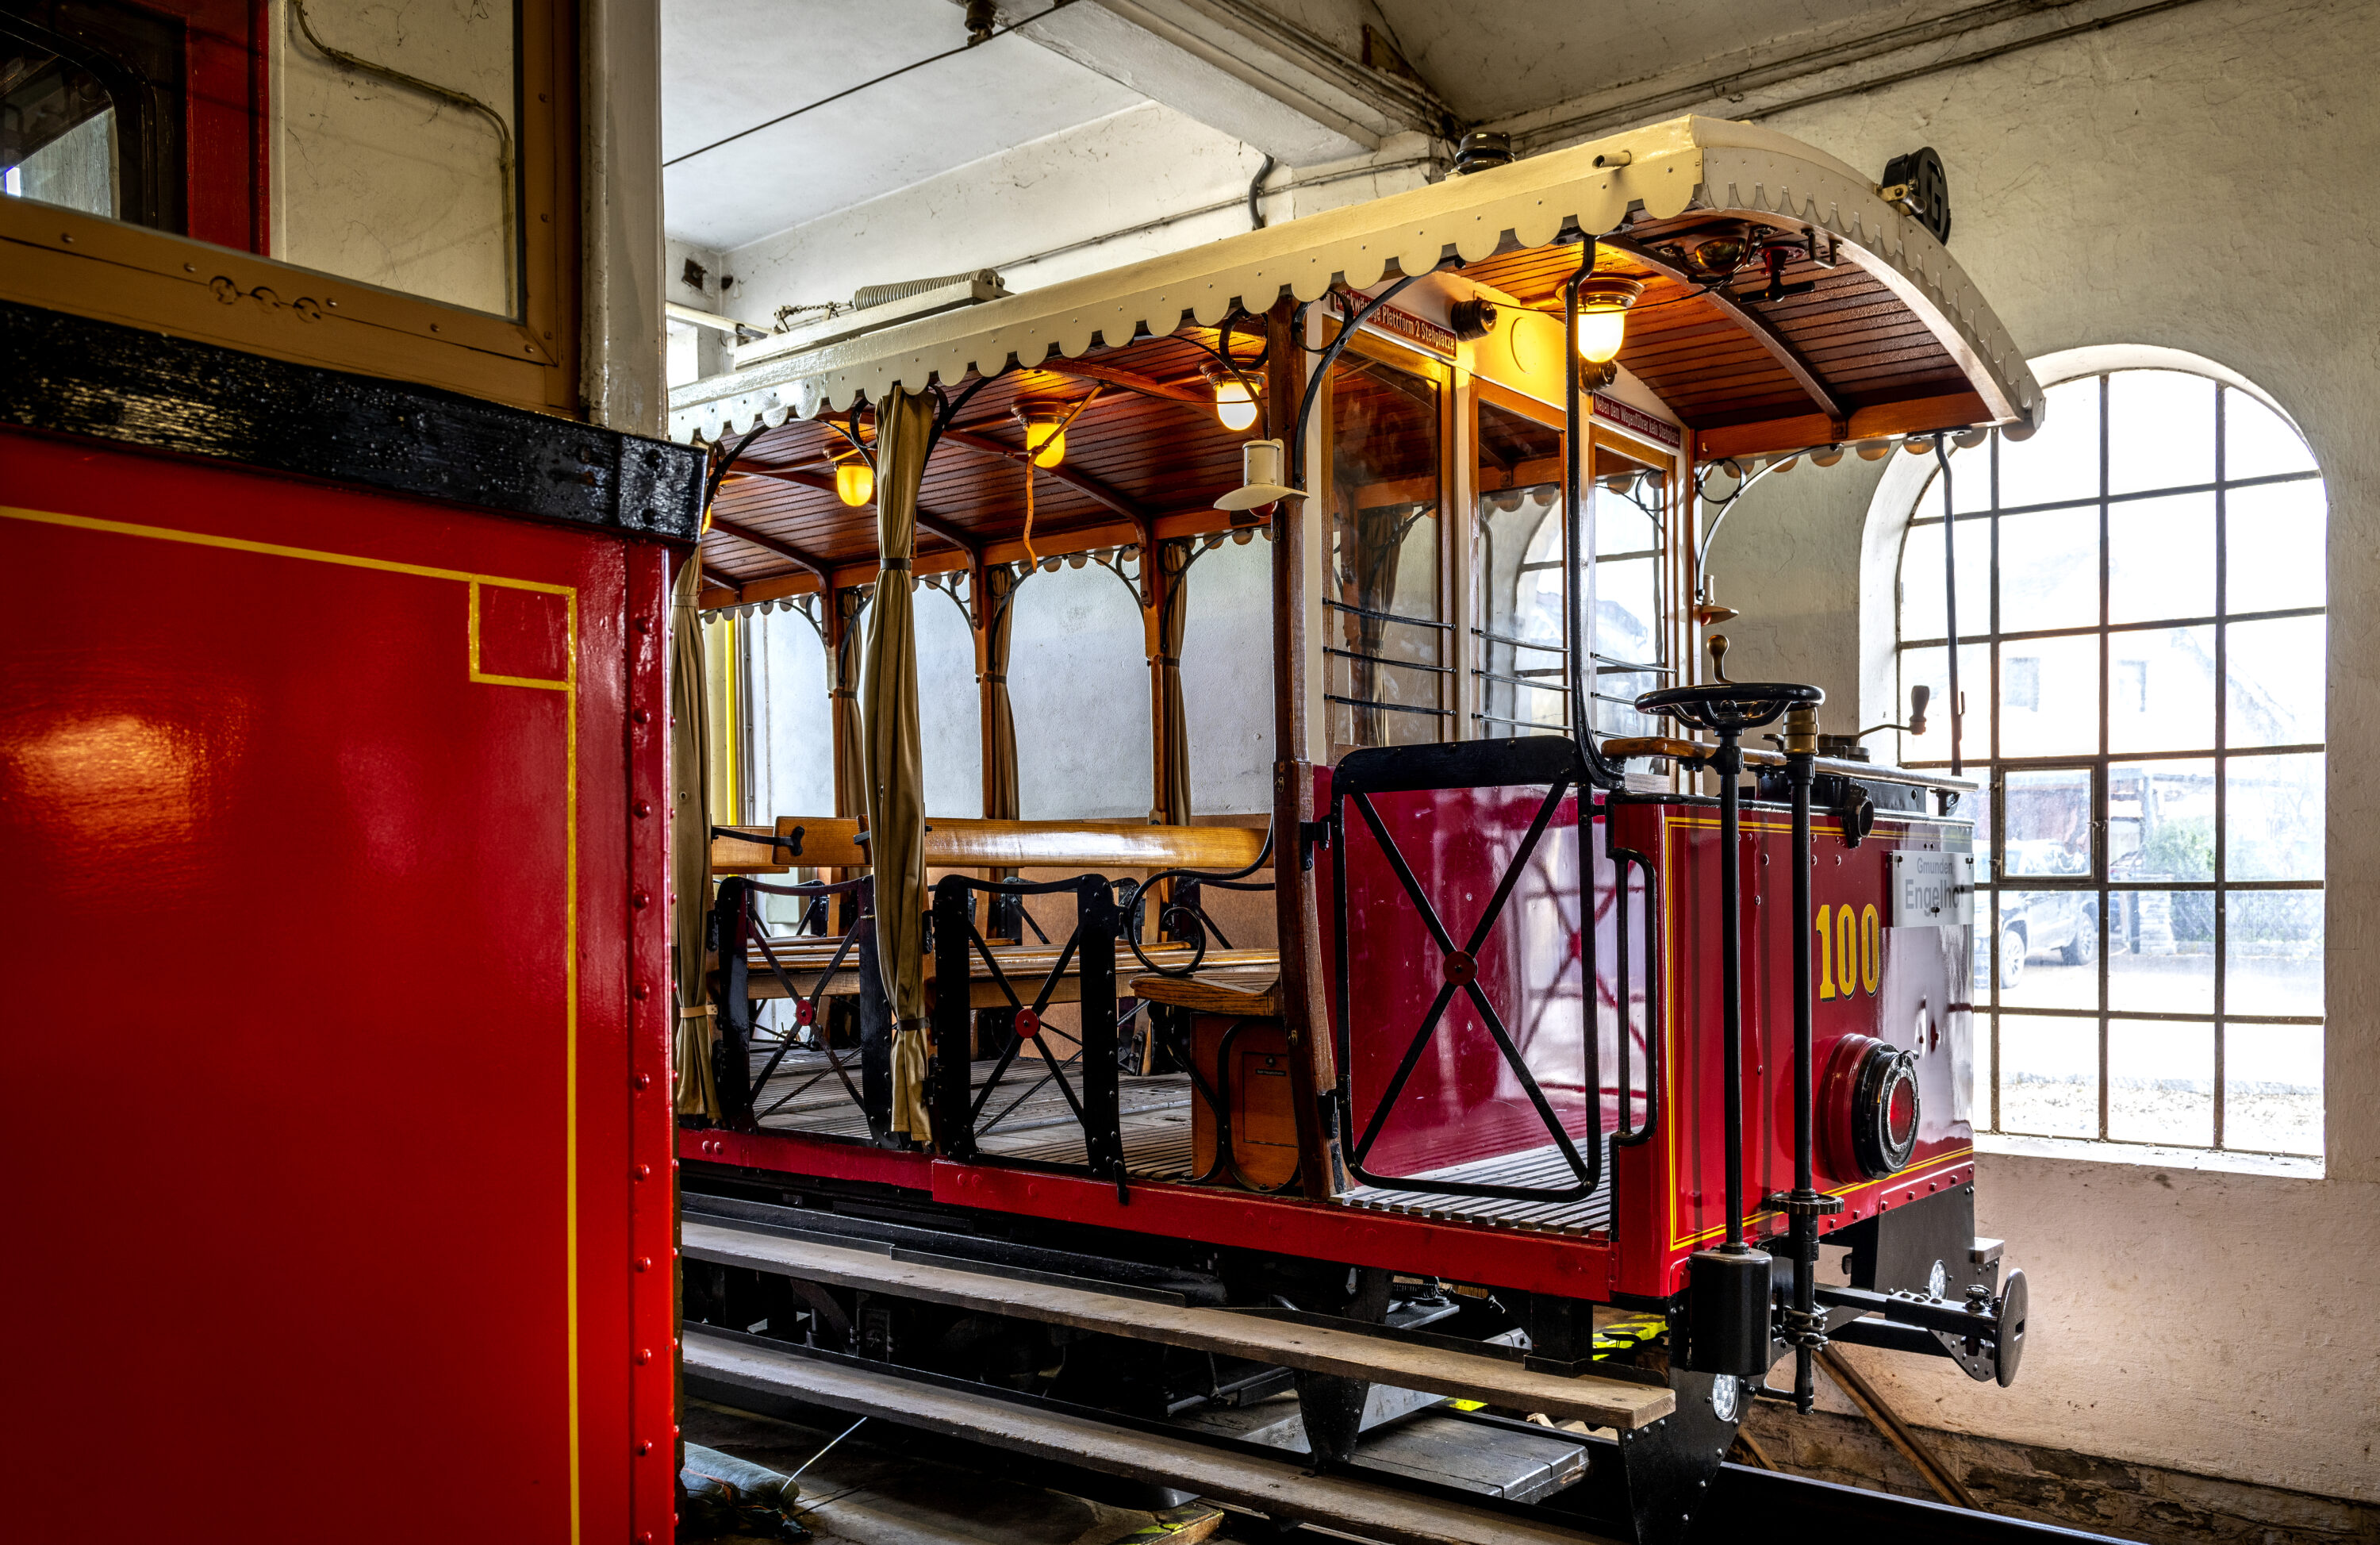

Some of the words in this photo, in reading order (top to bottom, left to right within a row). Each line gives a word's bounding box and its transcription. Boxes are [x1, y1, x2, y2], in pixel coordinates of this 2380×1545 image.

[1382, 306, 1414, 335] Plattform
[1415, 320, 1420, 337] 2
[1422, 324, 1454, 350] Stehplätze
[1595, 394, 1610, 414] Neben
[1610, 403, 1619, 419] dem
[1621, 407, 1648, 430] Wagenführer
[1649, 419, 1658, 436] kein
[1659, 425, 1679, 444] Stehplatz
[1917, 857, 1953, 874] Gmunden
[1816, 903, 1879, 1001] 100
